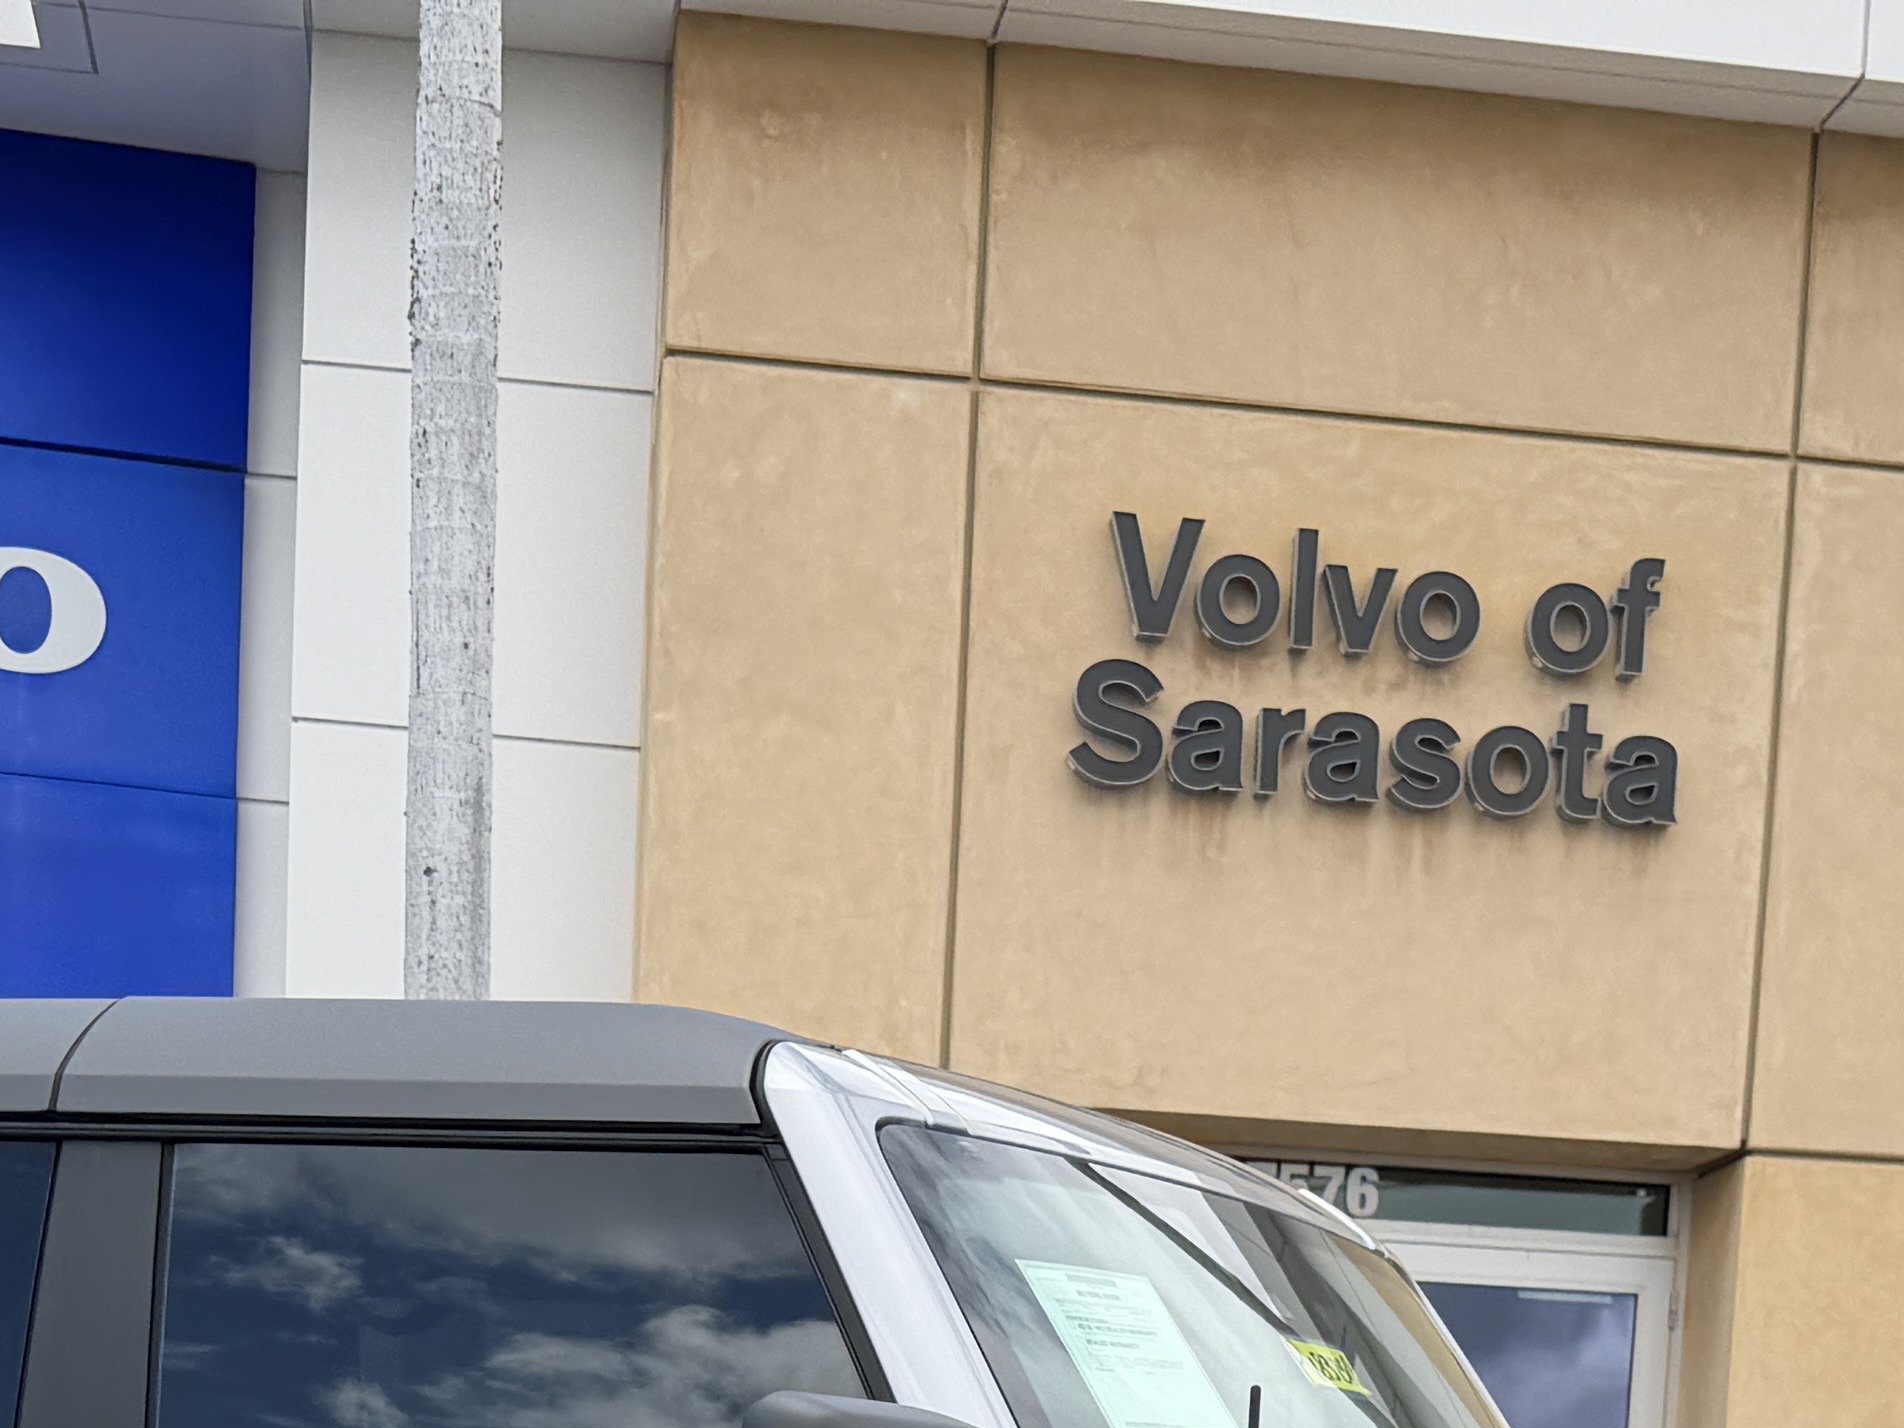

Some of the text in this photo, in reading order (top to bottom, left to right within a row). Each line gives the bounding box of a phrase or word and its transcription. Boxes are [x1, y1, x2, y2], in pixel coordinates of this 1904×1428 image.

[1110, 510, 1667, 681] Volvo of
[1067, 658, 1679, 828] Sarasota
